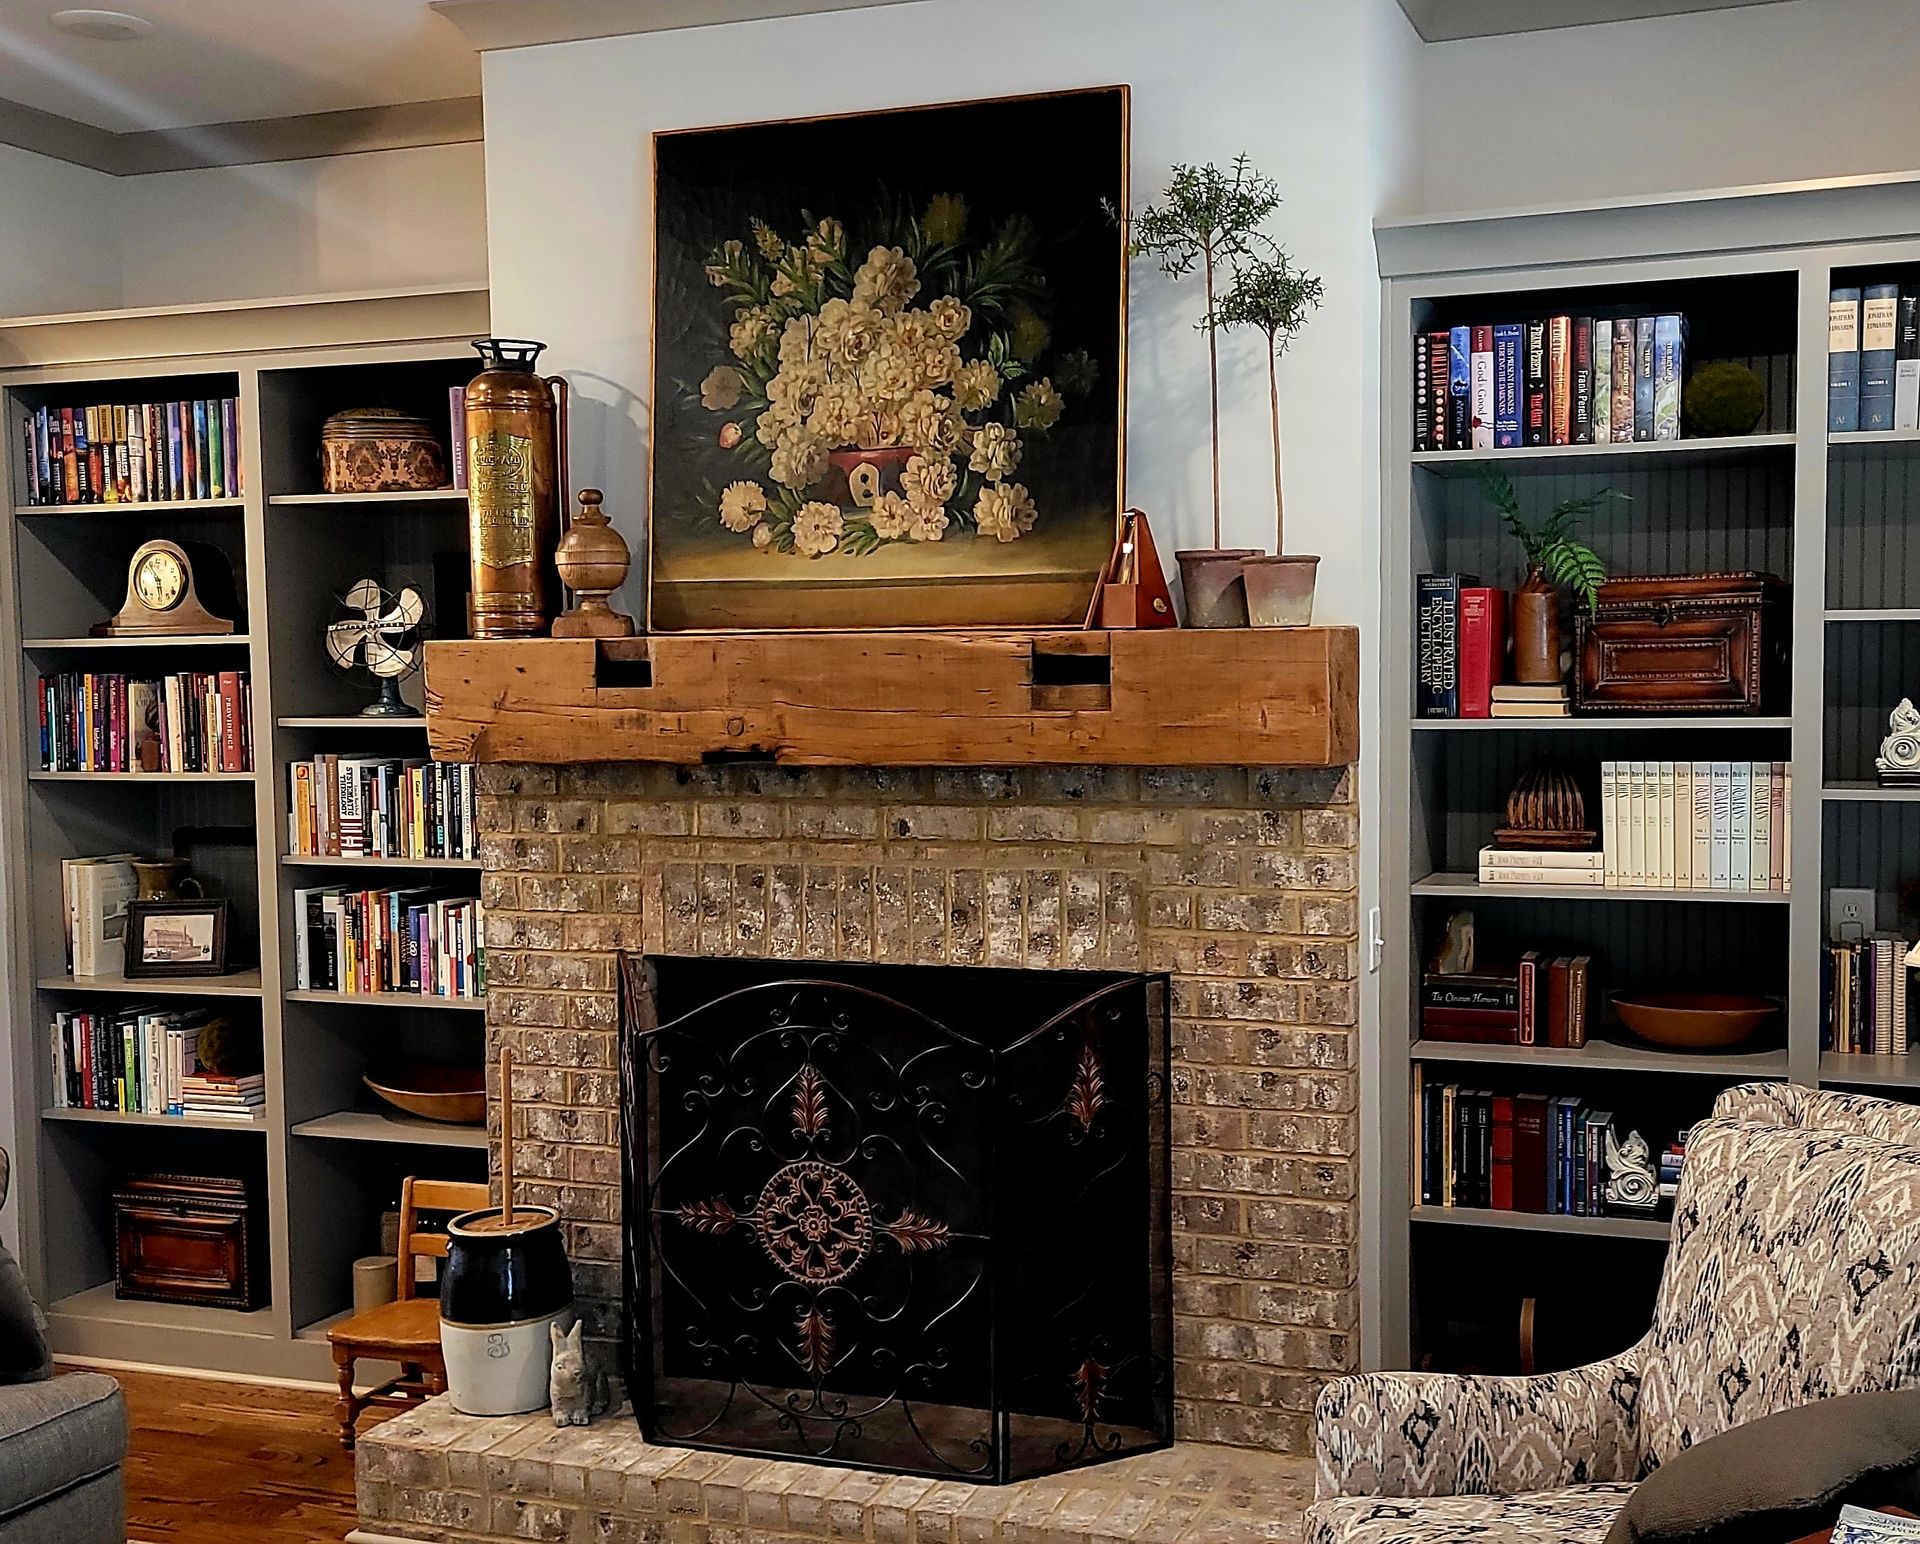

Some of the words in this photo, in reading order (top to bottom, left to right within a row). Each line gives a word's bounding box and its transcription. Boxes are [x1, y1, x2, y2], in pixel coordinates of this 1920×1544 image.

[1868, 312, 1893, 320] JONATHAN
[1478, 361, 1486, 381] God
[1578, 370, 1587, 393] Frank
[1478, 389, 1486, 415] Good
[1578, 396, 1587, 423] Peretti
[1417, 409, 1427, 437] ALCORN
[1421, 607, 1431, 685] DICTIONARY
[1432, 597, 1442, 694] ENCYCLOPEDIC
[1443, 601, 1455, 689] ILLUSTRATED
[225, 697, 233, 750] PROVIDENCE
[346, 767, 354, 816] SYSTEMATIC
[1695, 785, 1709, 820] ROMANS
[1714, 785, 1728, 820] ROMANS
[1733, 785, 1746, 820] ROMANS
[1755, 785, 1769, 820] ROMANS
[1431, 992, 1442, 1001] The
[1868, 1516, 1920, 1528] ISHNESS
